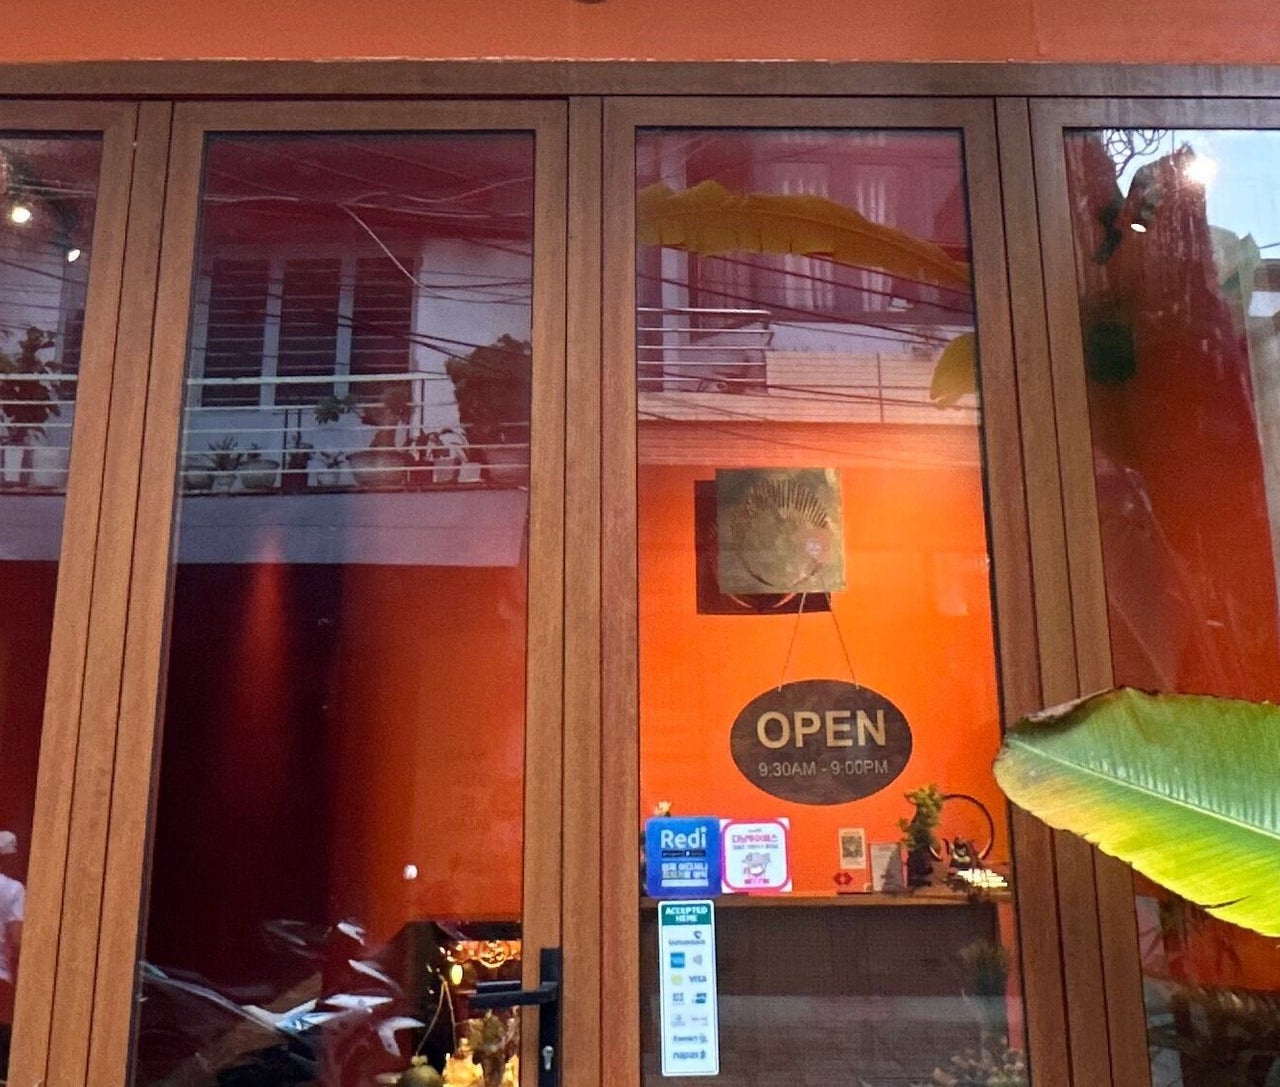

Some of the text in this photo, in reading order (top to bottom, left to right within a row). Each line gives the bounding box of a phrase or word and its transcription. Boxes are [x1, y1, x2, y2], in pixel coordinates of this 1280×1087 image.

[756, 709, 887, 749] OPEN
[758, 761, 816, 777] 9:30AM
[830, 759, 888, 775] 9:00PM
[660, 826, 707, 849] Redi
[665, 906, 708, 915] ACCEPTED
[675, 914, 698, 922] HERE
